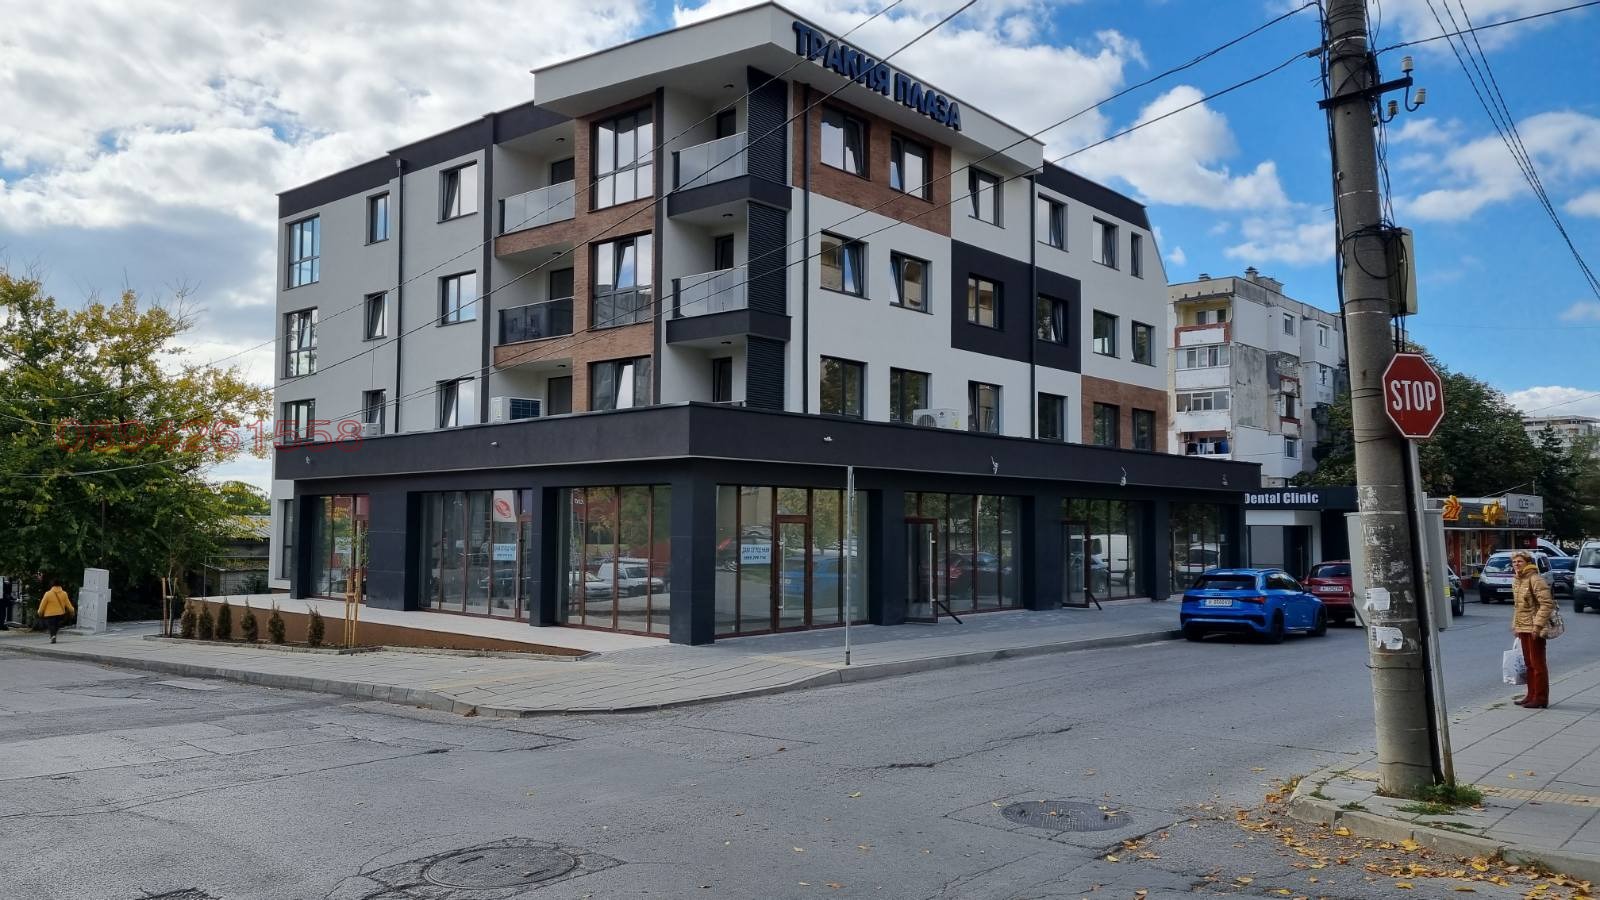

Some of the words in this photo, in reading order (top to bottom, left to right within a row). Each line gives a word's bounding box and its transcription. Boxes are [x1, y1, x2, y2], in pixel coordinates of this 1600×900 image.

[792, 21, 890, 95] ТРАКИЯ
[894, 73, 962, 131] ПЛАЗА
[1391, 380, 1436, 411] STOP
[1244, 493, 1280, 504] Dental
[1283, 492, 1319, 504] Clinic
